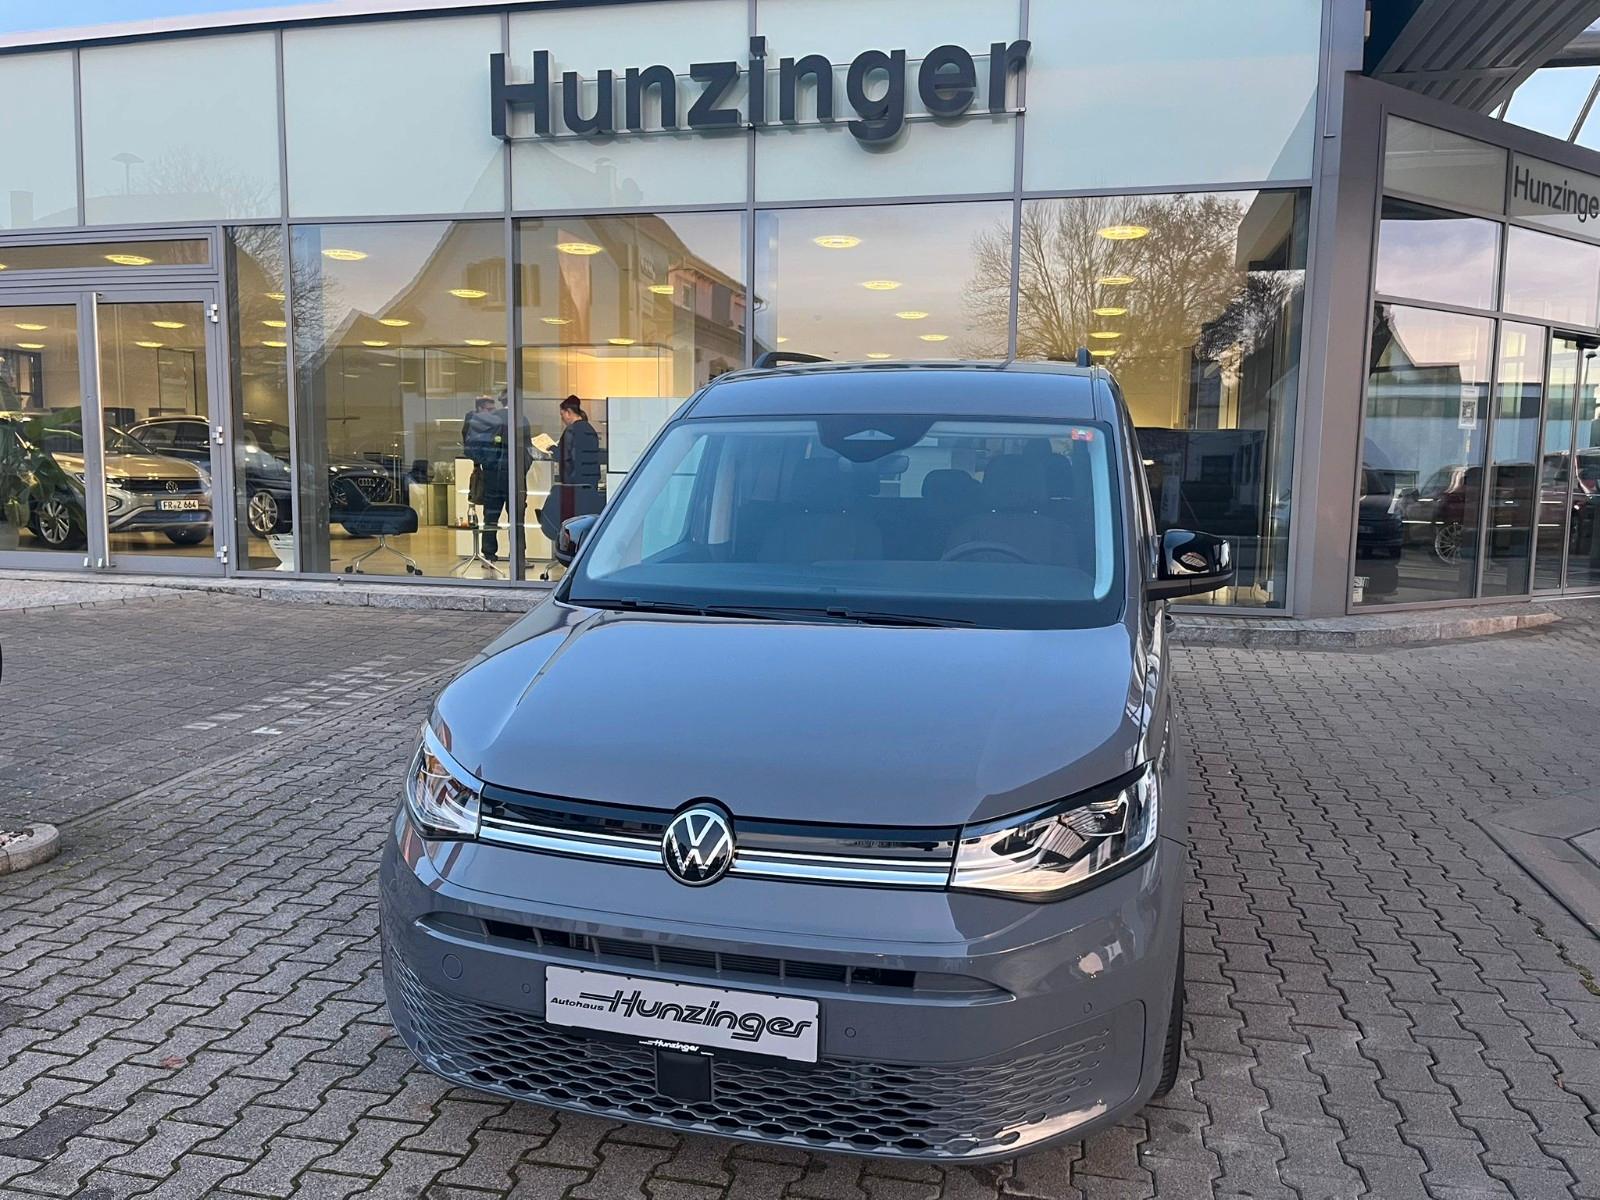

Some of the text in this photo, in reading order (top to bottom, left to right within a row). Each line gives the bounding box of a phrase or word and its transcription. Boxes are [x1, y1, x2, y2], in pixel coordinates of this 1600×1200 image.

[490, 36, 1031, 153] Hunzinger
[550, 989, 813, 1043] Autohaus Hunzinger
[648, 1039, 700, 1053] Hunzinger
